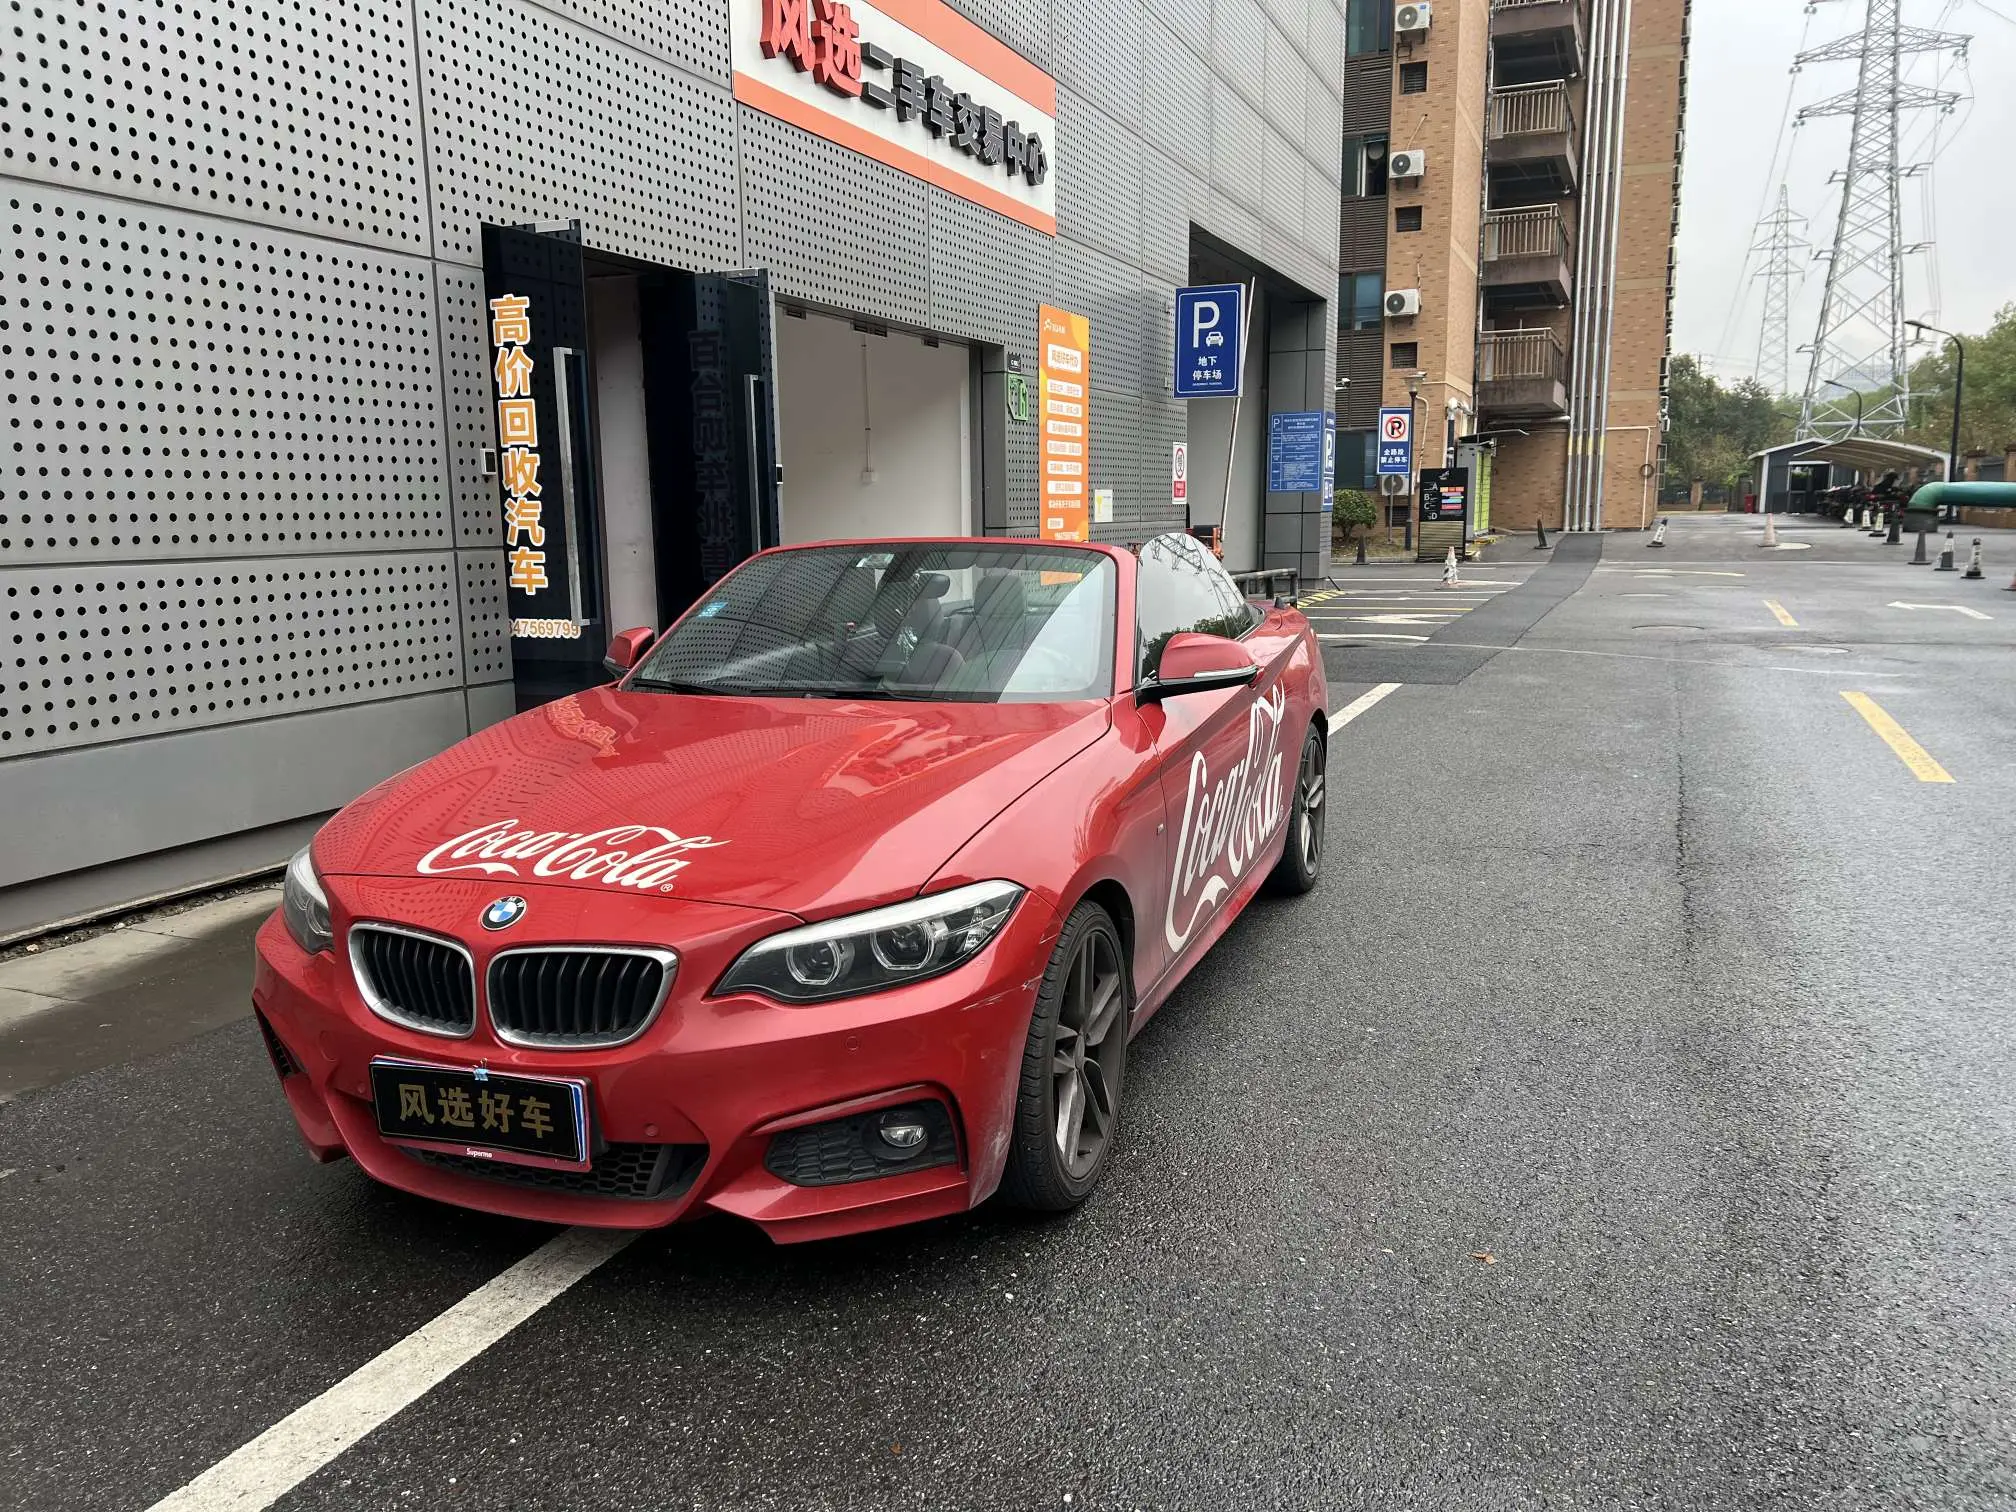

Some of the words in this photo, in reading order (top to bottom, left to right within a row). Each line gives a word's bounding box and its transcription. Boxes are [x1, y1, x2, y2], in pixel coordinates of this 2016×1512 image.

[1193, 301, 1220, 348] P
[1198, 355, 1218, 367] 地下
[1192, 369, 1223, 381] 停车场
[489, 294, 549, 596] 高价回收汽车
[1432, 482, 1438, 491] A
[1431, 512, 1438, 520] D
[398, 1083, 554, 1139] 风选好车
